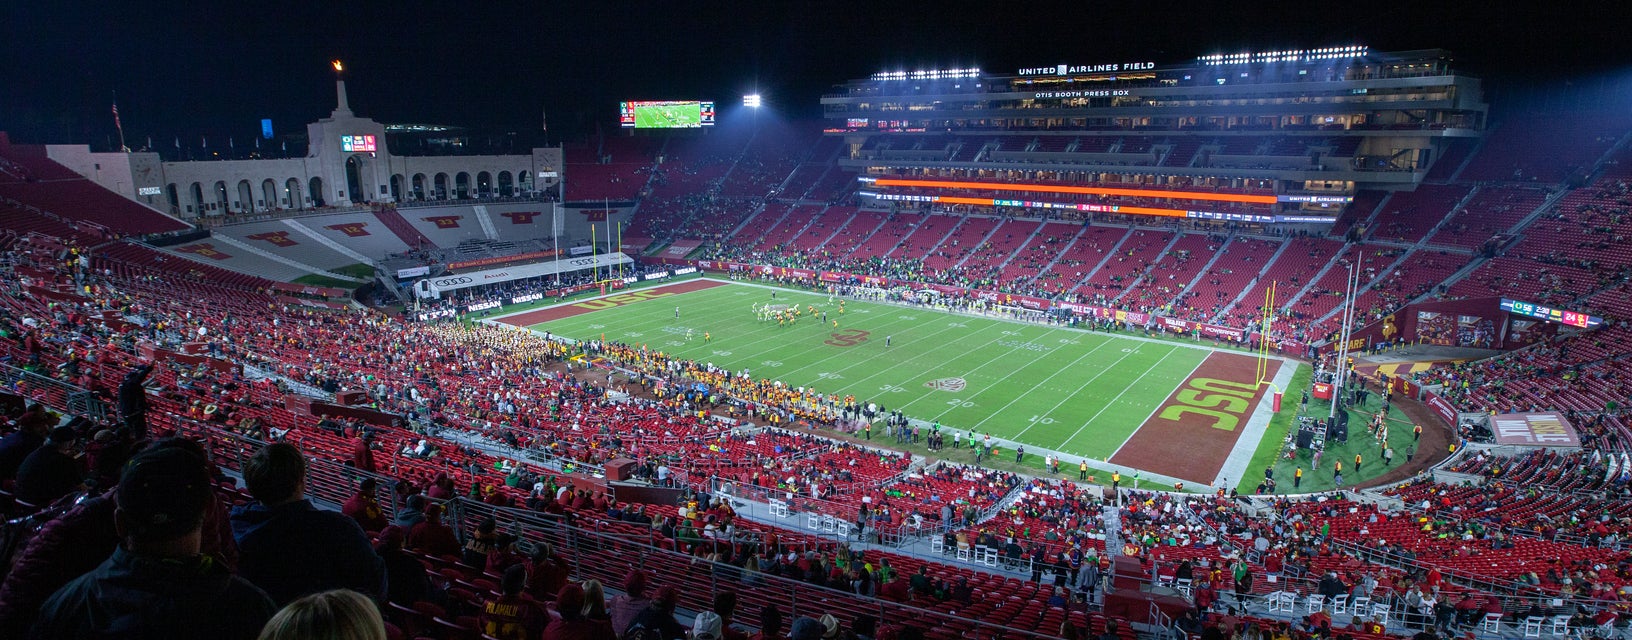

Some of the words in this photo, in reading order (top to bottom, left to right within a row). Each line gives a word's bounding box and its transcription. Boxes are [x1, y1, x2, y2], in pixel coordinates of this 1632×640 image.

[1019, 67, 1056, 75] UNITED
[1068, 64, 1118, 73] AIRLINES
[1123, 62, 1155, 70] FIELD
[484, 271, 509, 280] Audi
[645, 271, 669, 280] NISSAN
[675, 266, 697, 275] NISSAN
[512, 292, 543, 304] NISSAN
[572, 289, 676, 310] USC
[468, 300, 501, 312] NISSAN
[1536, 306, 1550, 314] 2:30
[1419, 311, 1431, 319] 34
[1565, 313, 1576, 321] 24
[1205, 326, 1240, 336] POWERADE
[1348, 338, 1365, 350] ARE
[946, 398, 975, 408] 20
[1159, 377, 1260, 432] USC
[1028, 414, 1056, 425] 10
